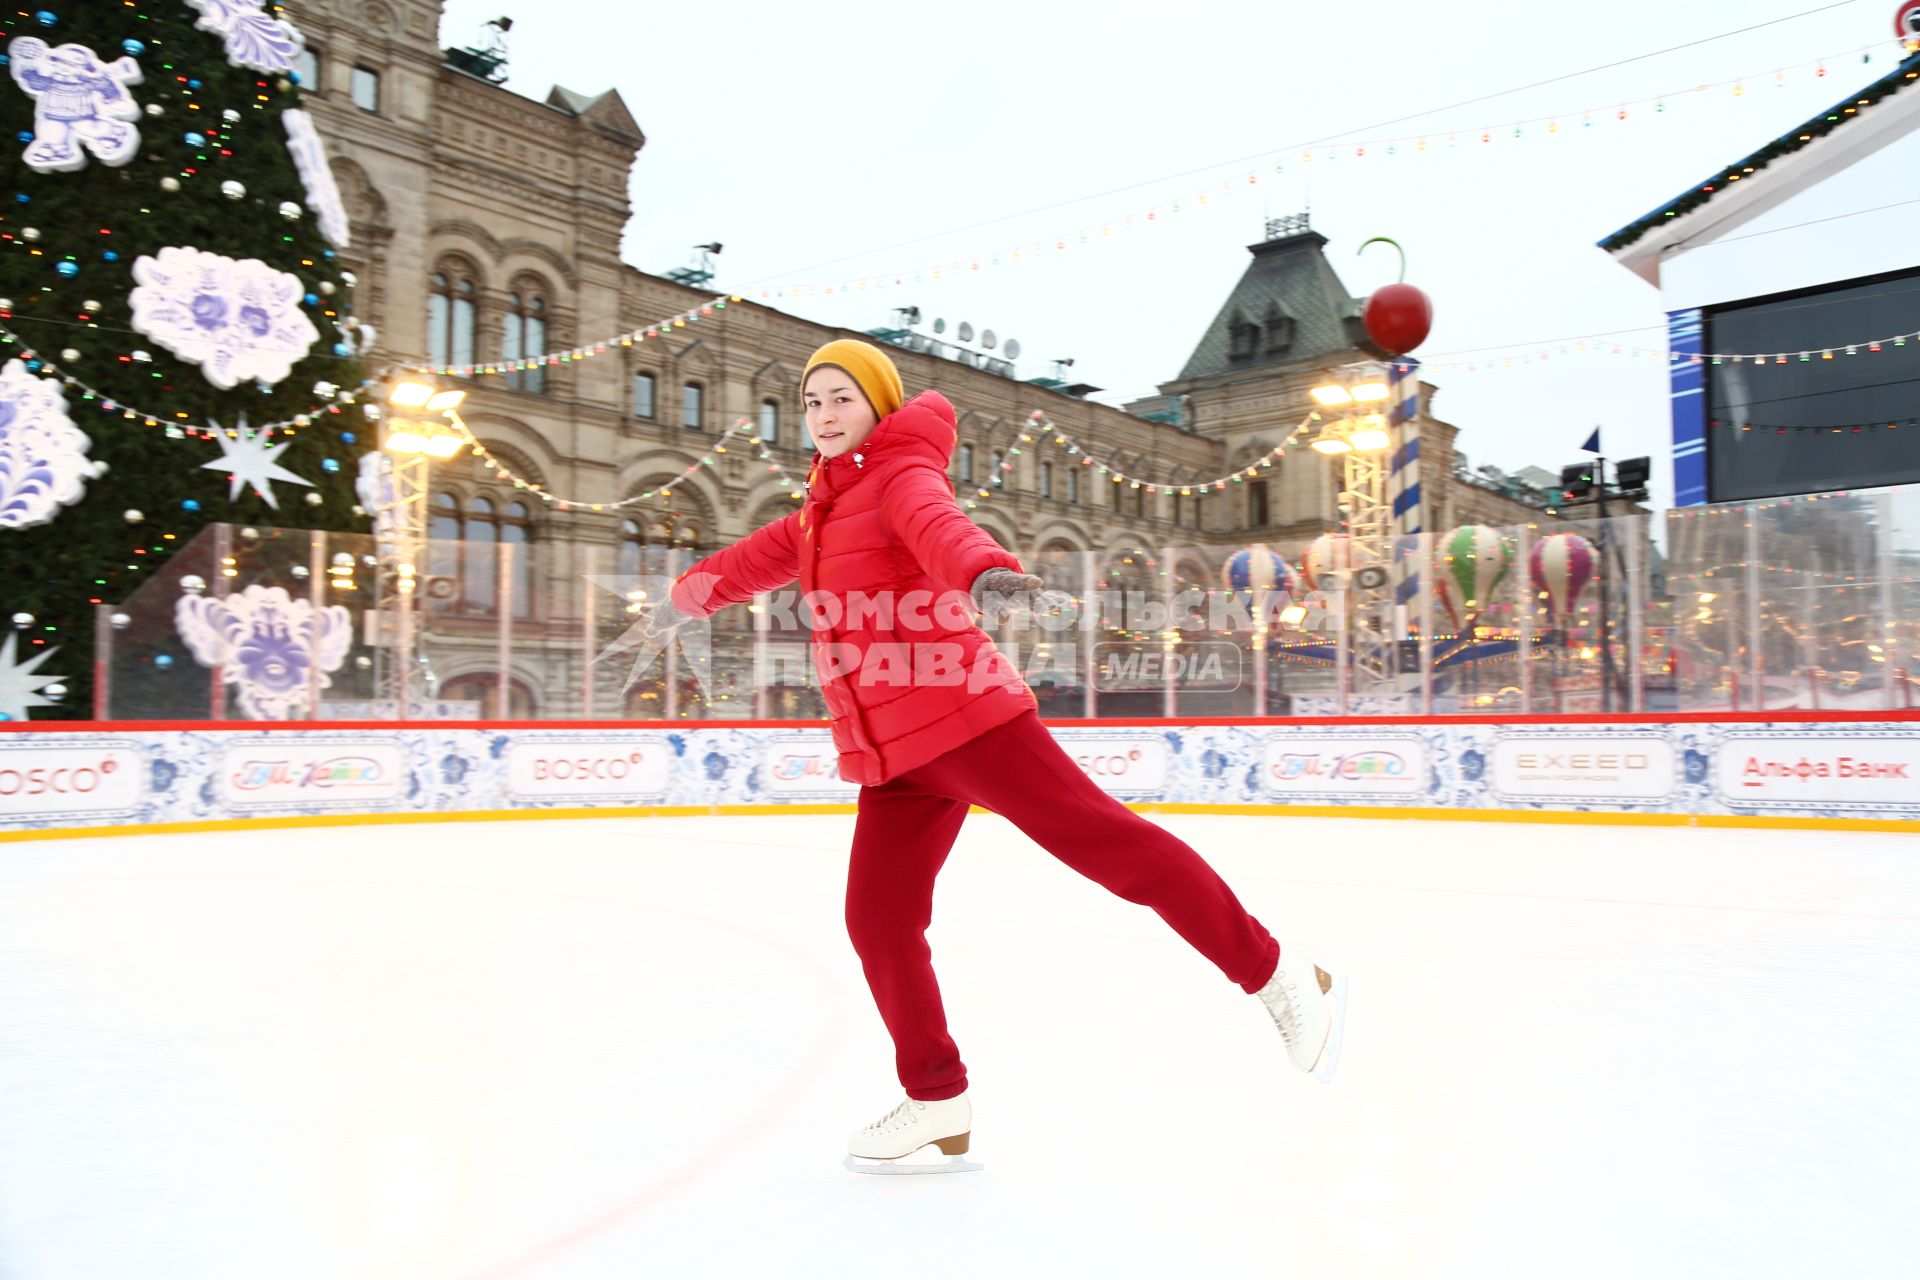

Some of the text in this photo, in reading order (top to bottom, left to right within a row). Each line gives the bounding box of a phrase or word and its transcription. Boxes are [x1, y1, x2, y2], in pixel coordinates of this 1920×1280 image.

[533, 758, 629, 781] BOSCO
[1078, 756, 1128, 776] SCO
[1516, 753, 1649, 770] EXEED
[1742, 756, 1910, 782] Альфа Банк
[0, 767, 100, 796] OSCO
